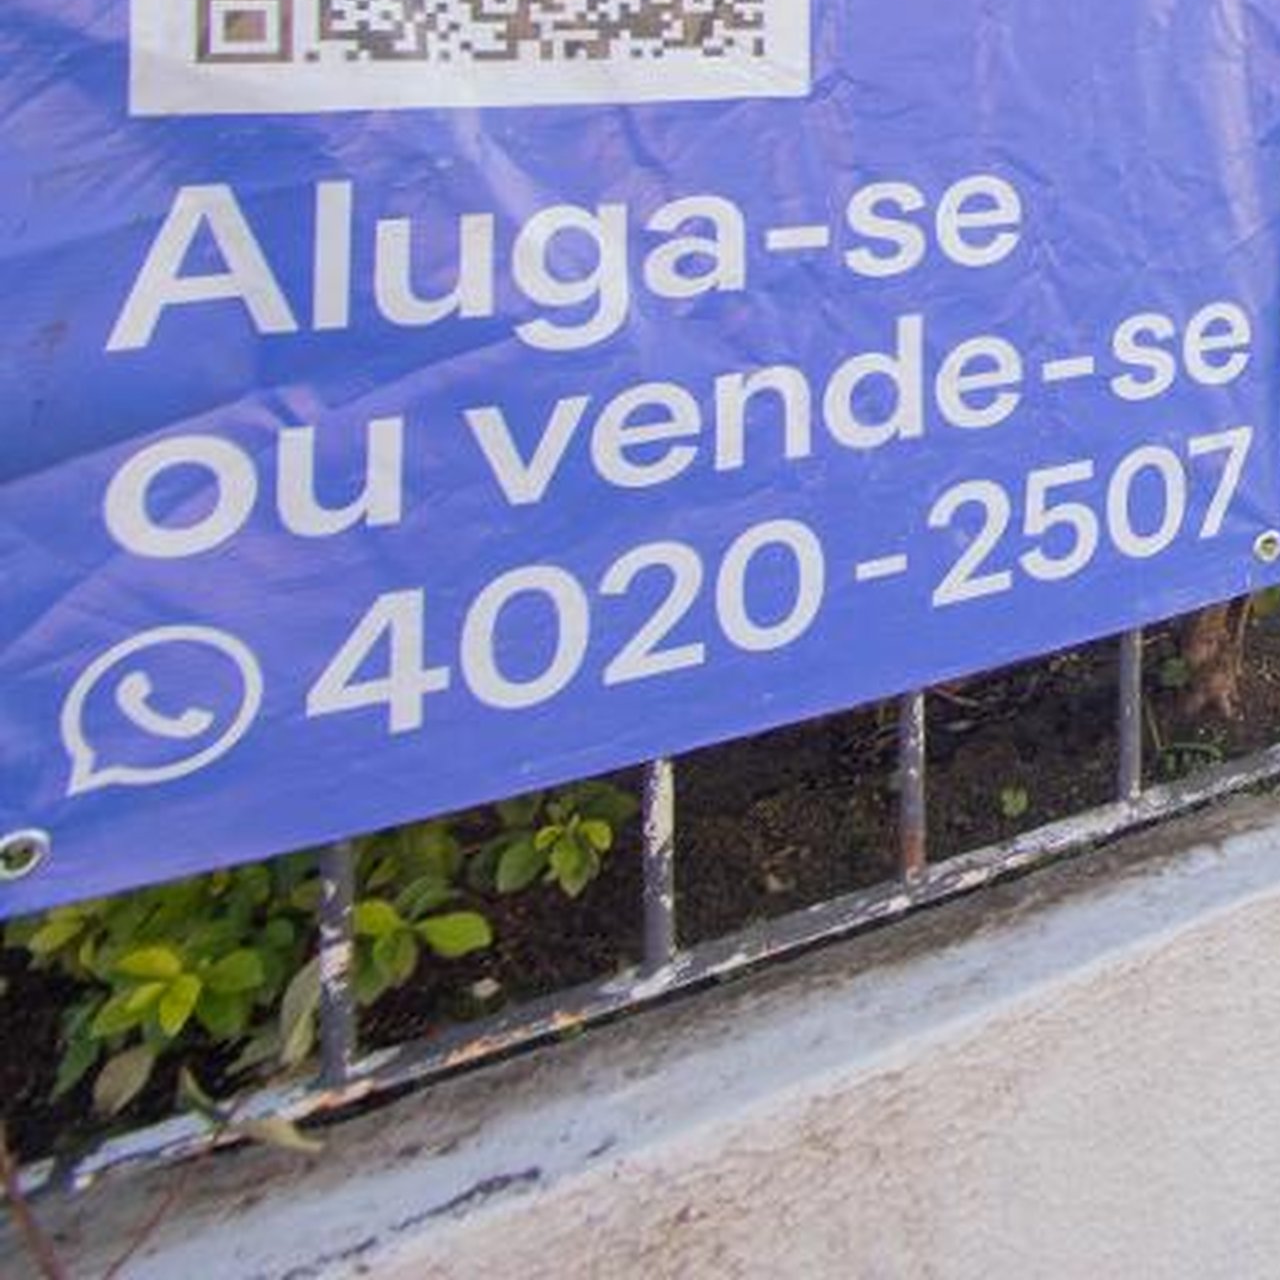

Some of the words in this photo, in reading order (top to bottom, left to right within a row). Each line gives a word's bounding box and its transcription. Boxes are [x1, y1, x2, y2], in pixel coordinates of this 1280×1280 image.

[106, 174, 1022, 351] Aluga-se
[104, 417, 403, 560] ou
[468, 302, 1252, 503] vende-se
